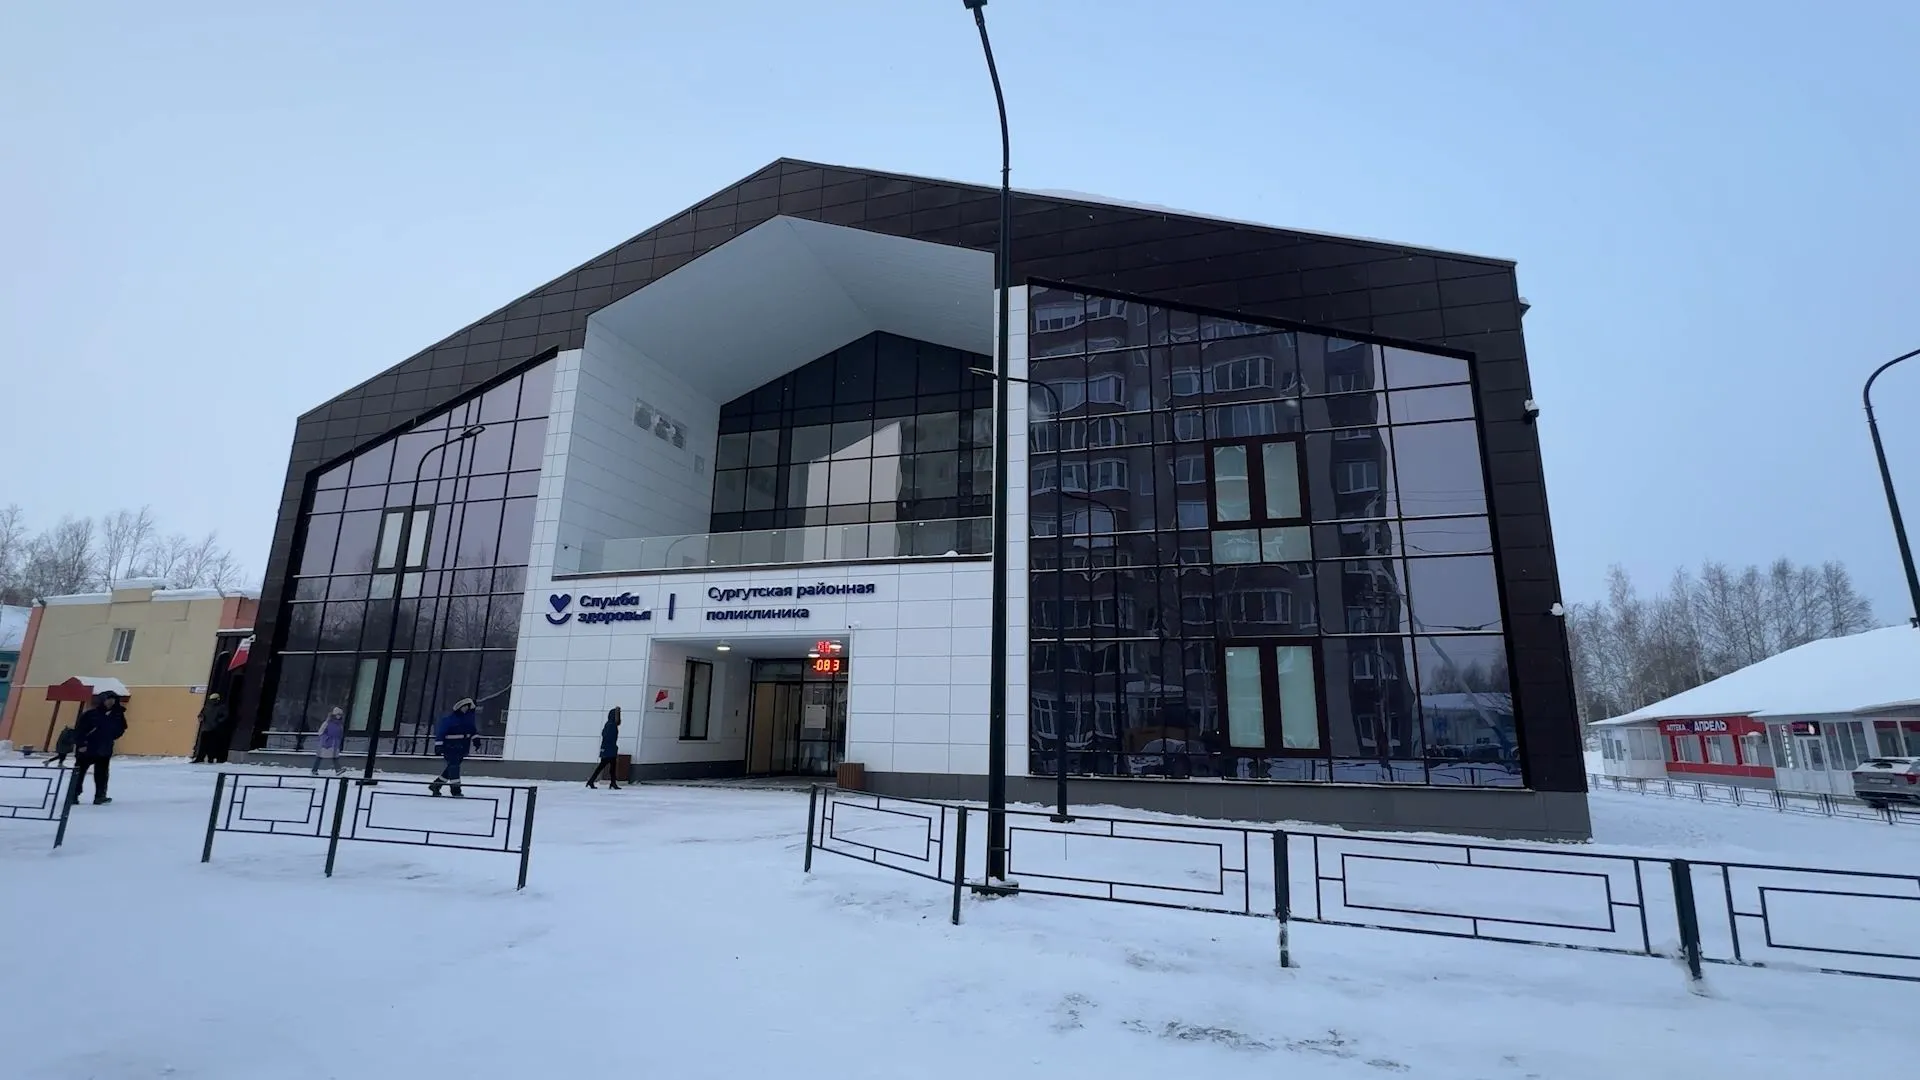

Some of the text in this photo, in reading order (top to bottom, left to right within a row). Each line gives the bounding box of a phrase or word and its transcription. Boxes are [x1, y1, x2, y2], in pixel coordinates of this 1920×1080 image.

[707, 582, 876, 602] Сургутская районная
[580, 592, 641, 610] Служба
[578, 610, 652, 625] здоровья
[706, 608, 810, 621] поликлиника
[1694, 720, 1727, 732] АПРЕЛЬ
